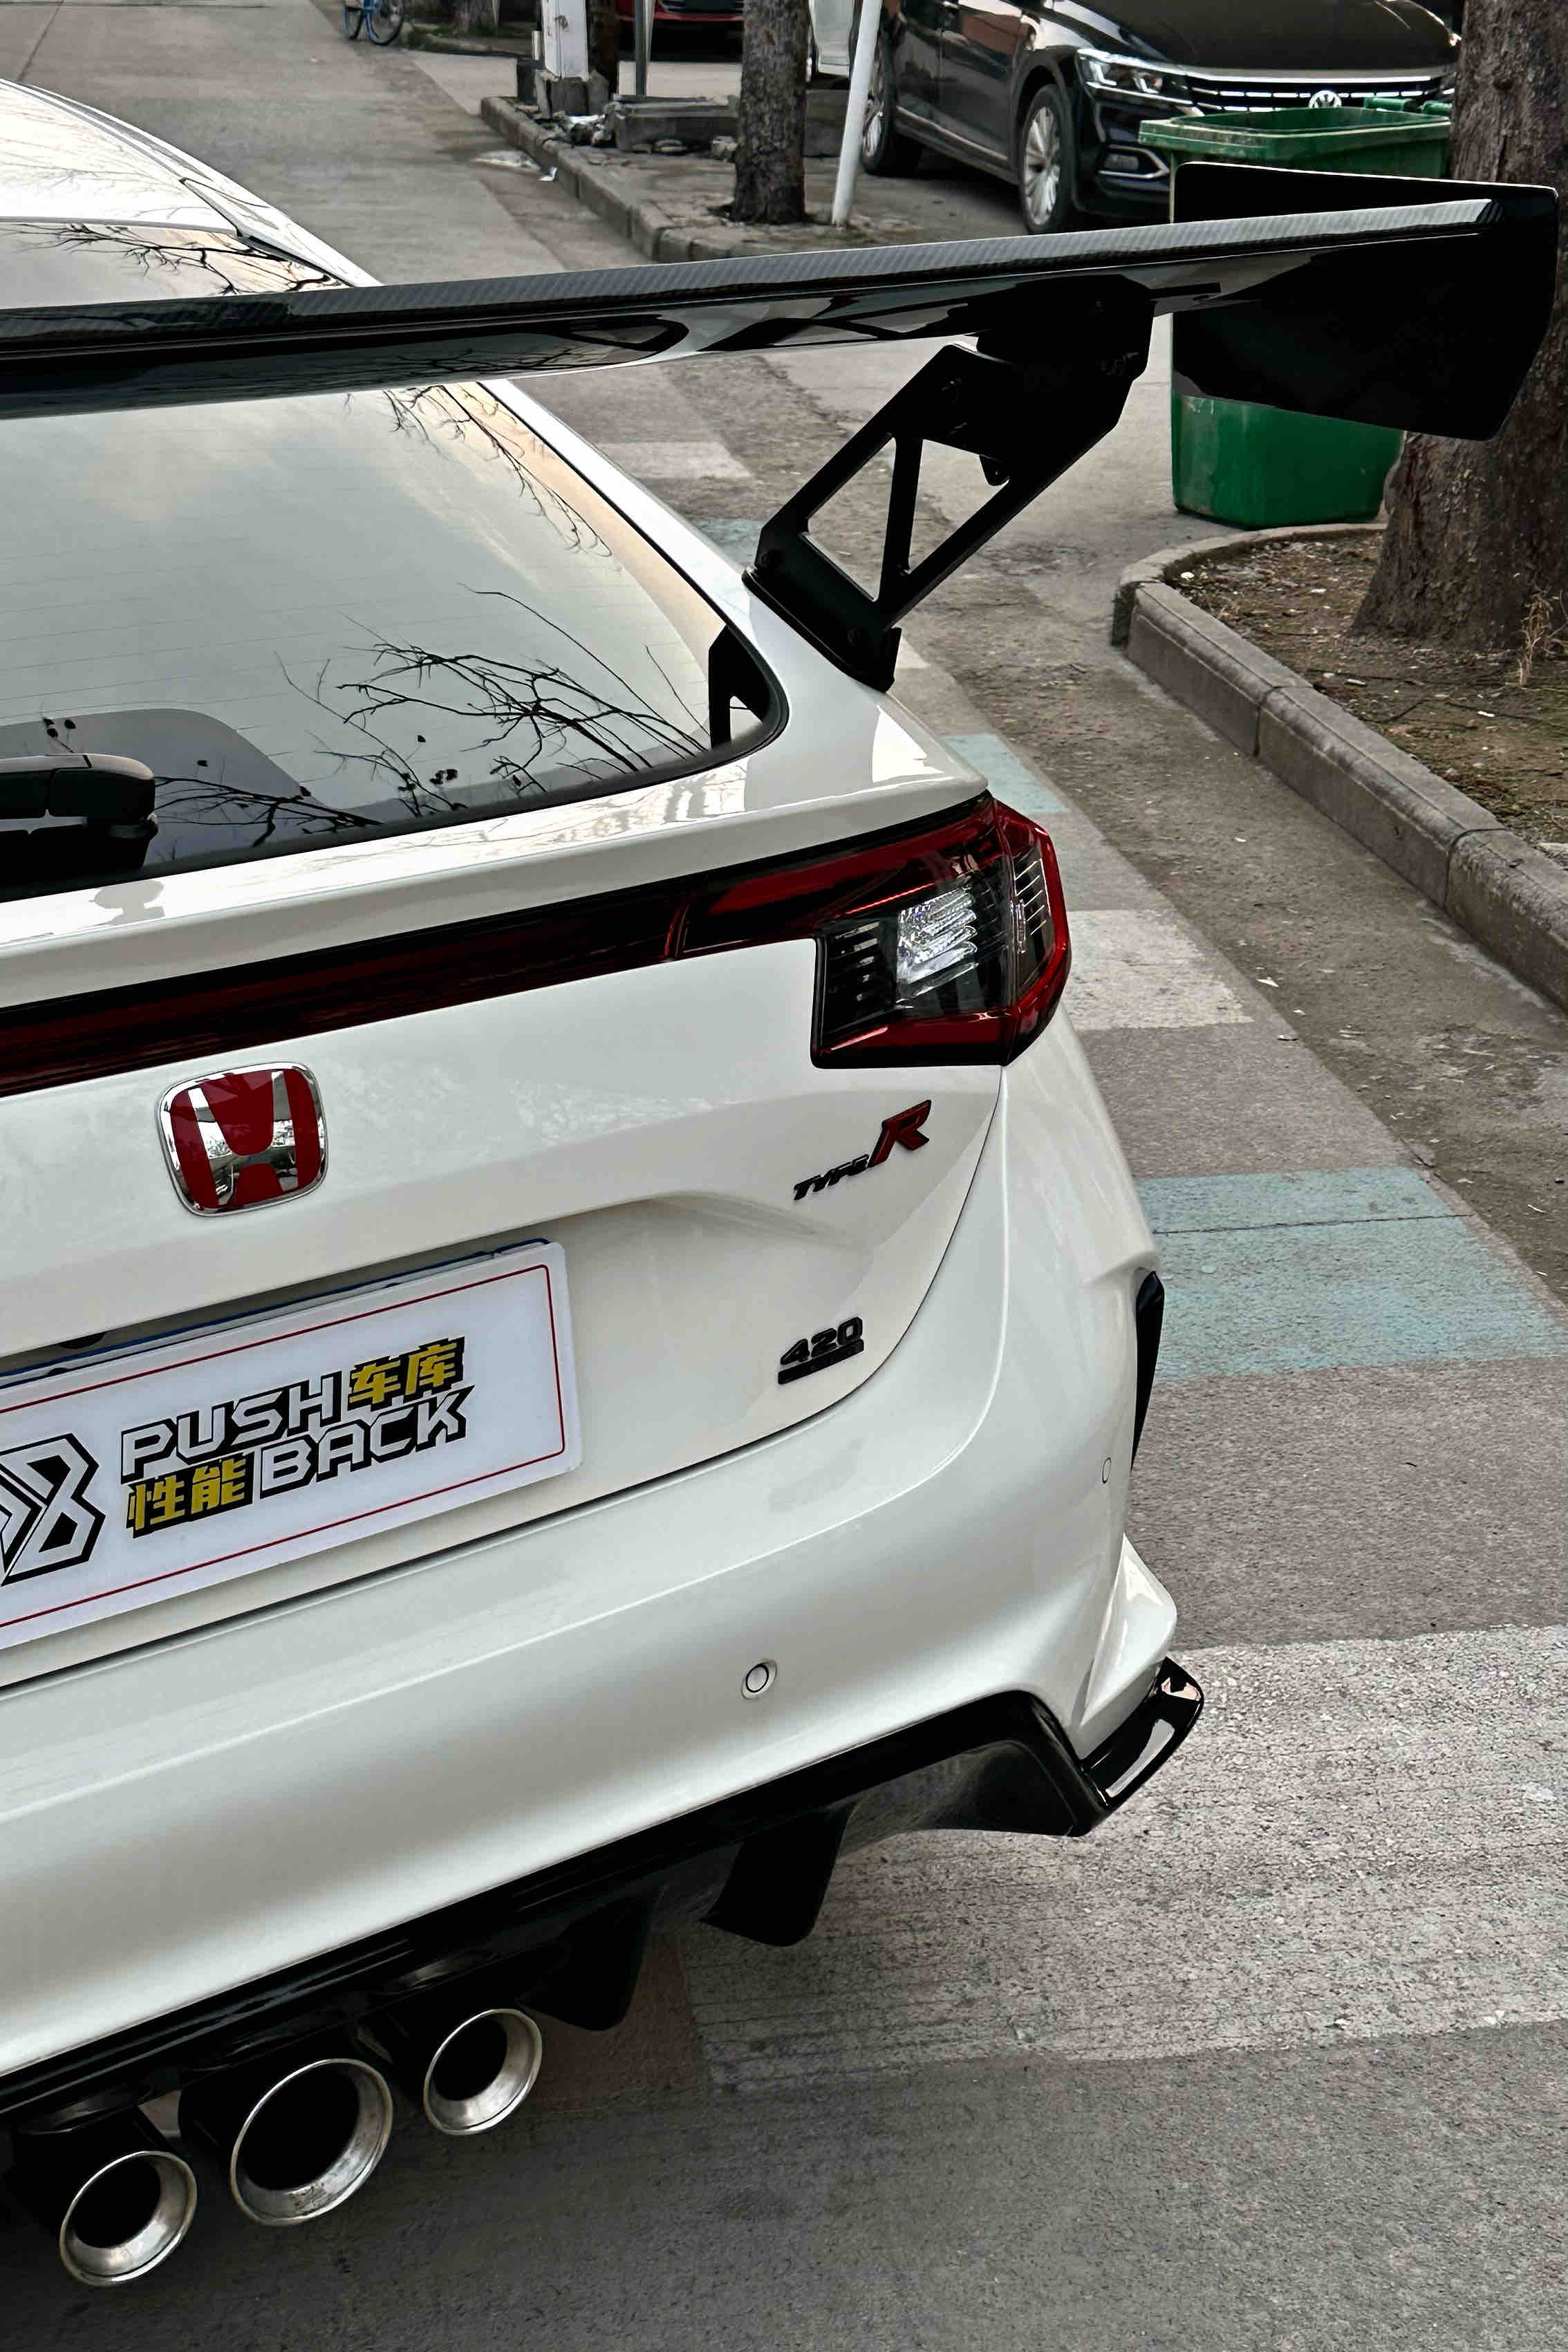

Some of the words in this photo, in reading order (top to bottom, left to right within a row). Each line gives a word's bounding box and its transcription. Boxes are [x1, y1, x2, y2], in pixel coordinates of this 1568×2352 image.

[867, 1099, 932, 1168] R
[779, 1316, 864, 1366] 420
[121, 1372, 342, 1484] PUSH
[348, 1338, 464, 1410] 车库
[127, 1454, 254, 1536] 性能
[260, 1386, 474, 1499] BACK
